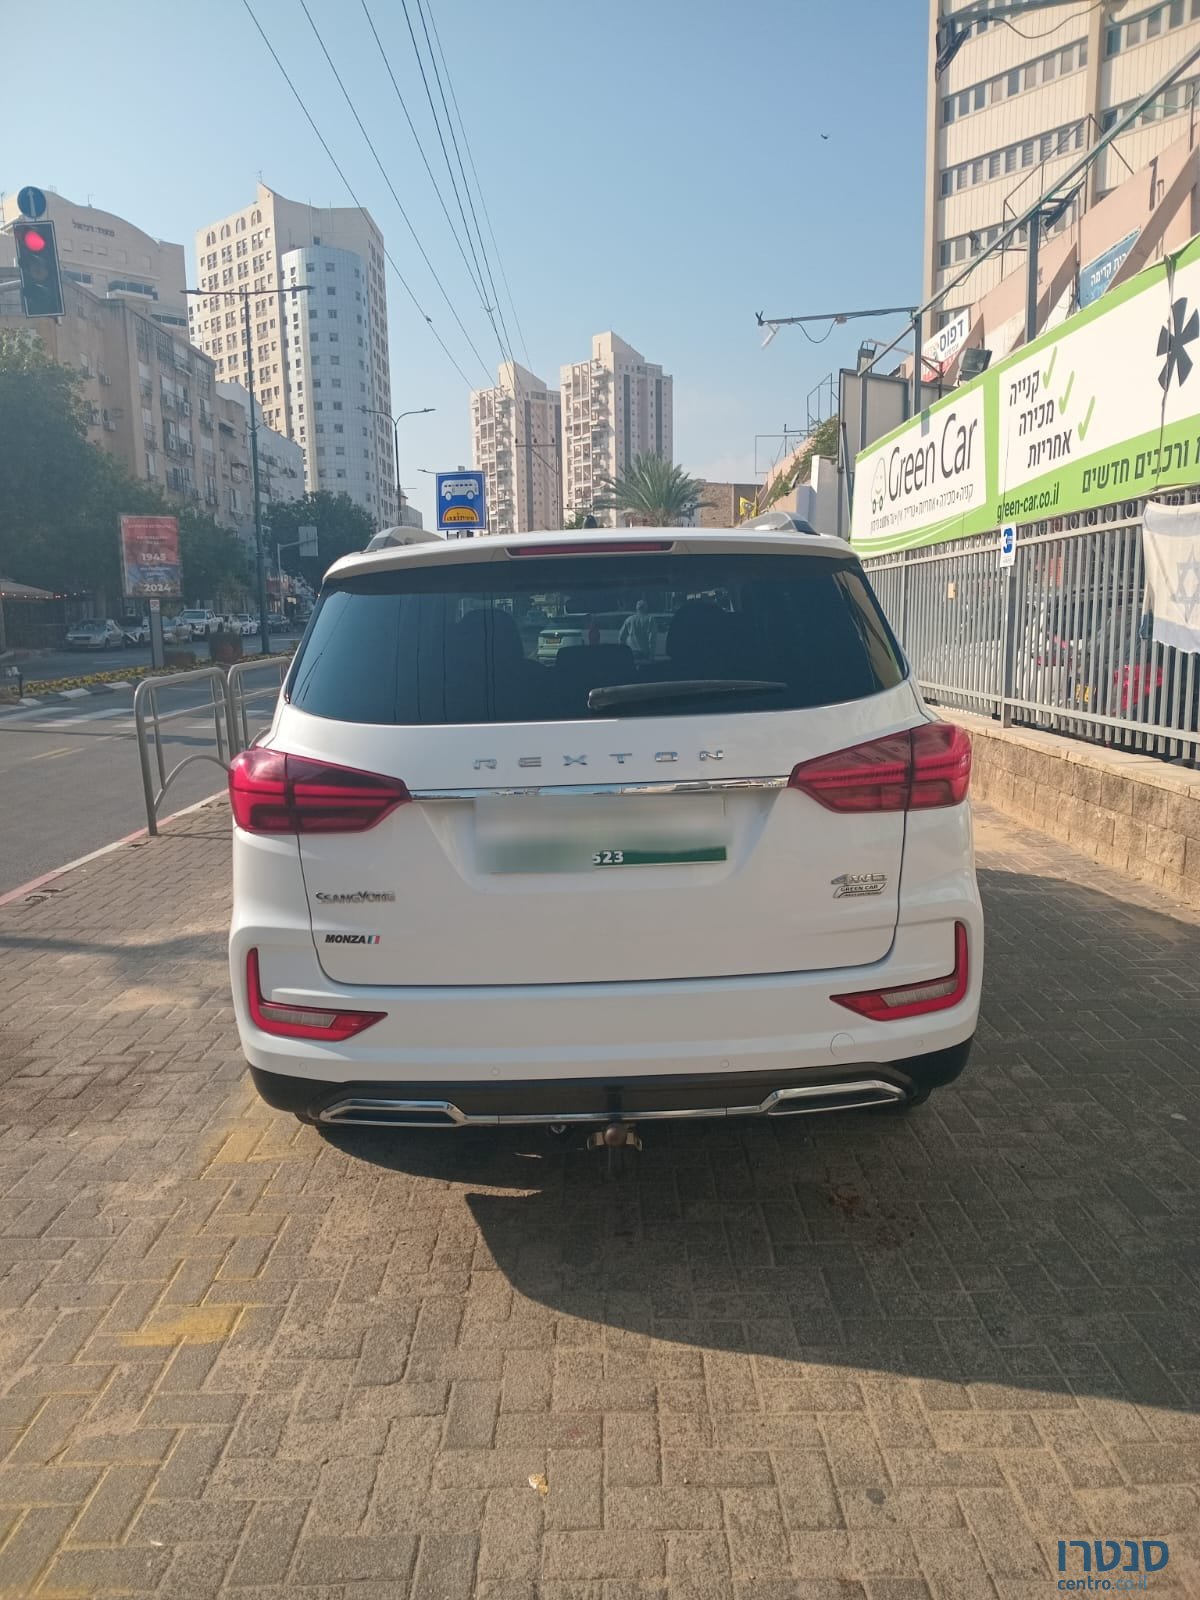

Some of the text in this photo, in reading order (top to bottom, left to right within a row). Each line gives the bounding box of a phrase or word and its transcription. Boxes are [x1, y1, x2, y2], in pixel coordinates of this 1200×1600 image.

[939, 319, 964, 352] דפוס
[1009, 370, 1040, 407] קנייה
[1019, 399, 1055, 436] מכירה
[888, 413, 978, 501] Green Car
[1027, 428, 1073, 469] אחריות
[1134, 440, 1190, 480] ורכבים
[1082, 458, 1130, 493] חדשים
[997, 481, 1060, 523] green-car.co.il
[141, 552, 167, 562] 1945
[143, 583, 171, 593] 2024
[471, 750, 724, 770] REXTON
[325, 934, 366, 944] MONZA
